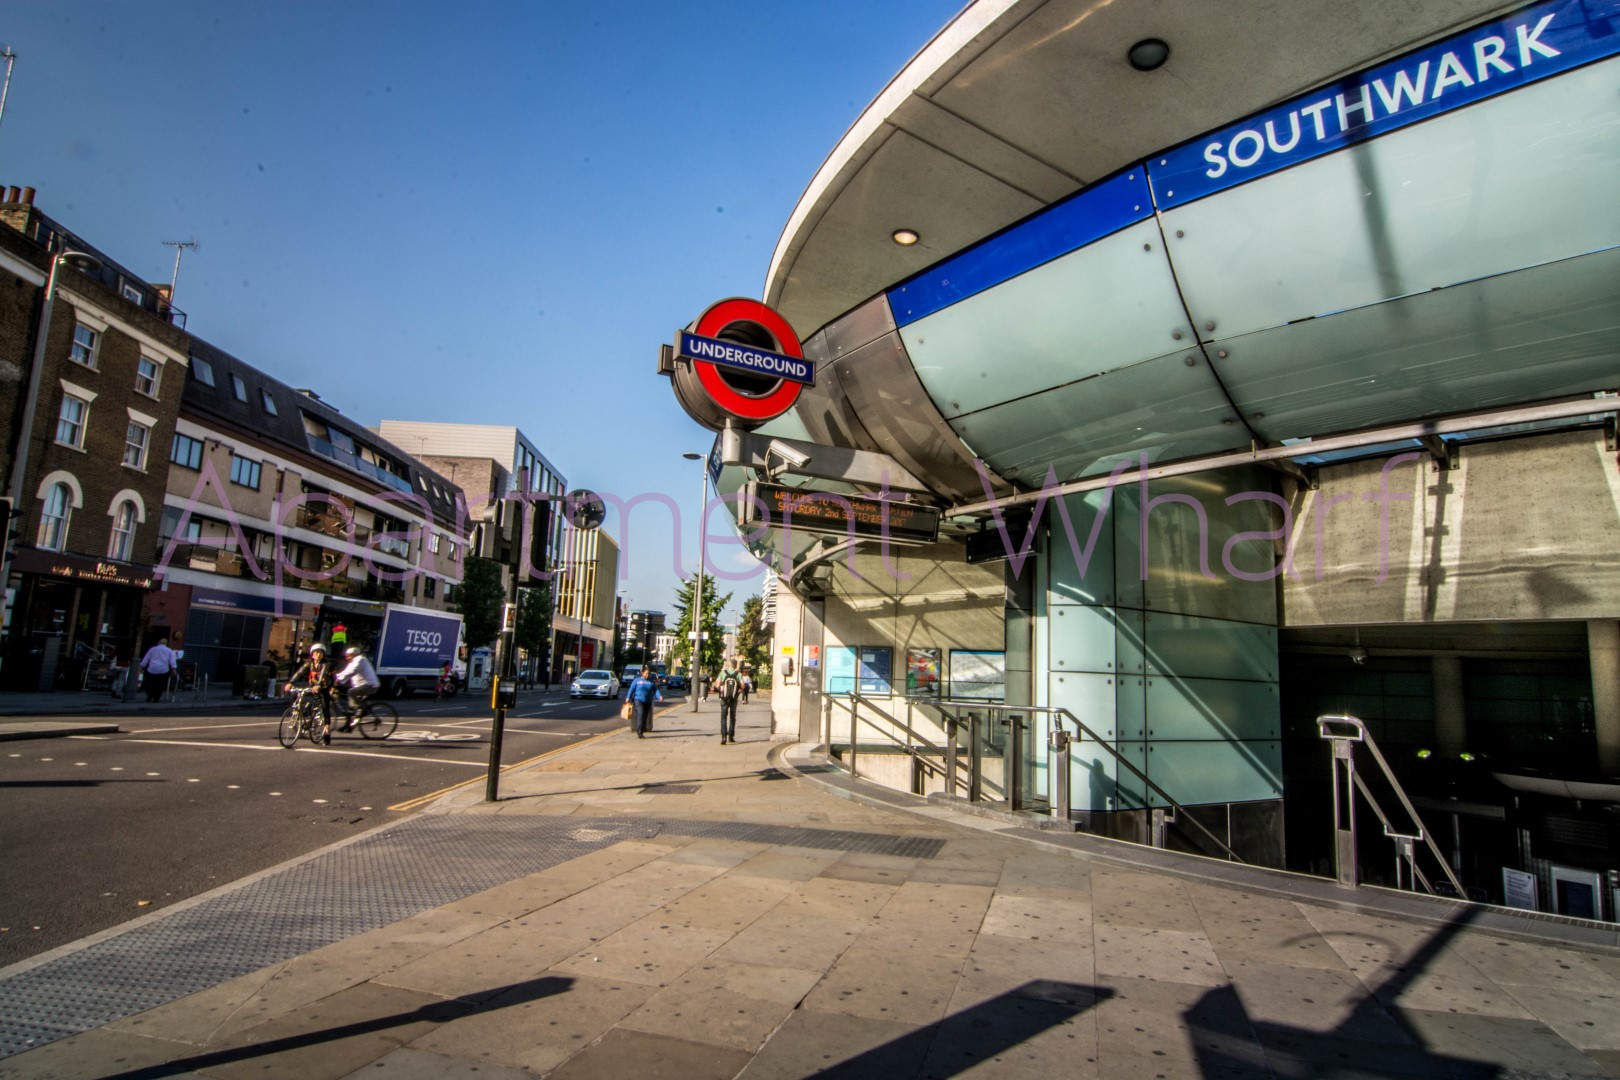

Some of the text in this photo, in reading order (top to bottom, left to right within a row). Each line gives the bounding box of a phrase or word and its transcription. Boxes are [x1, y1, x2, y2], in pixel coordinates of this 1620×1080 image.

[1203, 13, 1561, 178] SOUTHWARK
[690, 339, 807, 376] UNDERGROUND
[774, 490, 813, 503] WELCOME
[778, 501, 822, 516] SATURDAY
[824, 507, 839, 518] 2nd
[407, 629, 442, 646] TESCO
